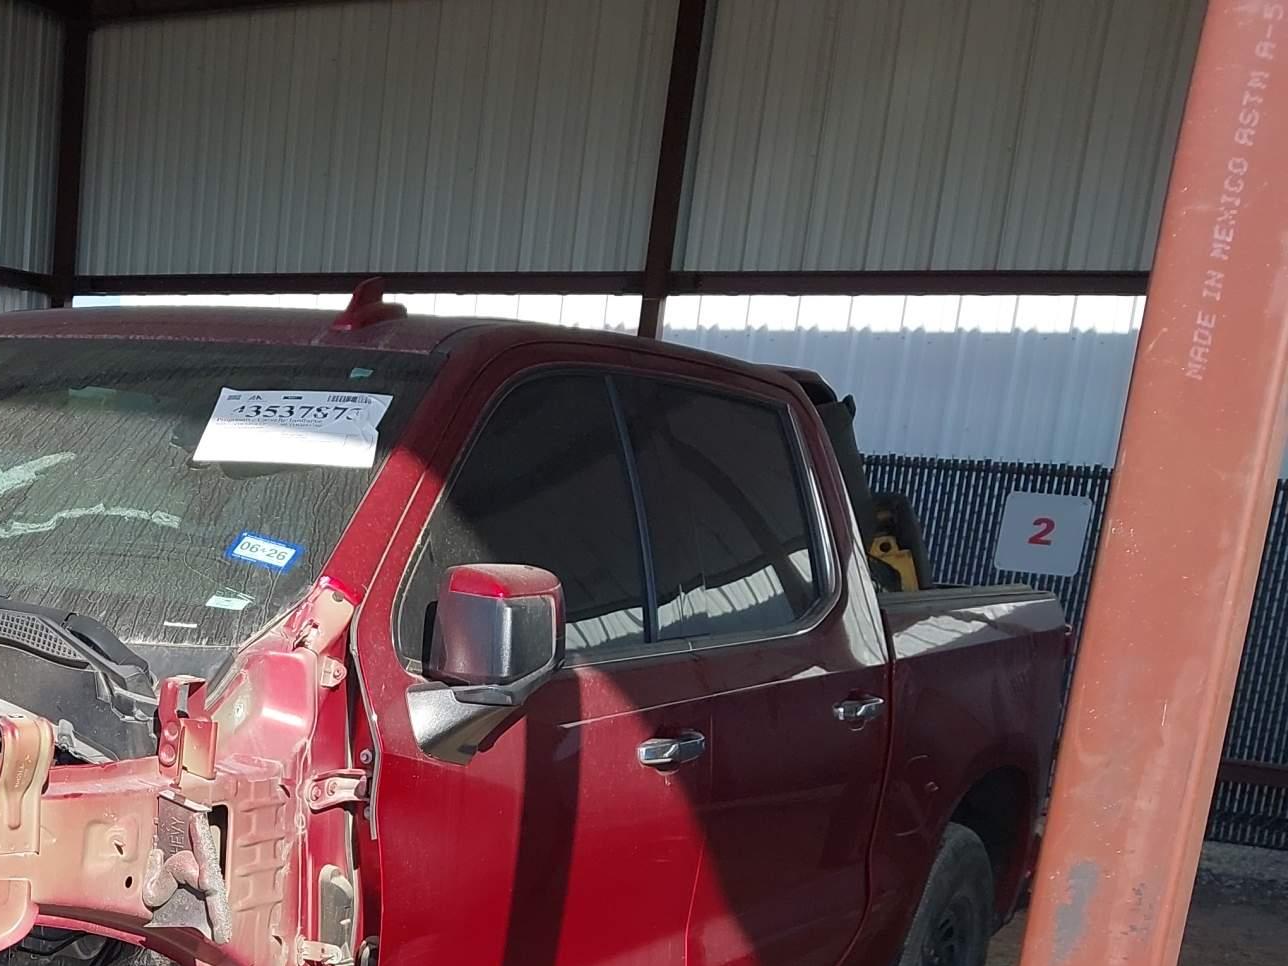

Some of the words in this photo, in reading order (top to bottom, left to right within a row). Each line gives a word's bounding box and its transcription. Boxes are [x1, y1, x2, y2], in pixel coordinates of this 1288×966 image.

[1234, 71, 1270, 147] ASTM
[1210, 157, 1249, 261] MEXICO
[1202, 269, 1225, 302] IN
[1185, 310, 1217, 381] MADE
[1027, 517, 1056, 546] 2
[168, 815, 186, 858] HEVY
